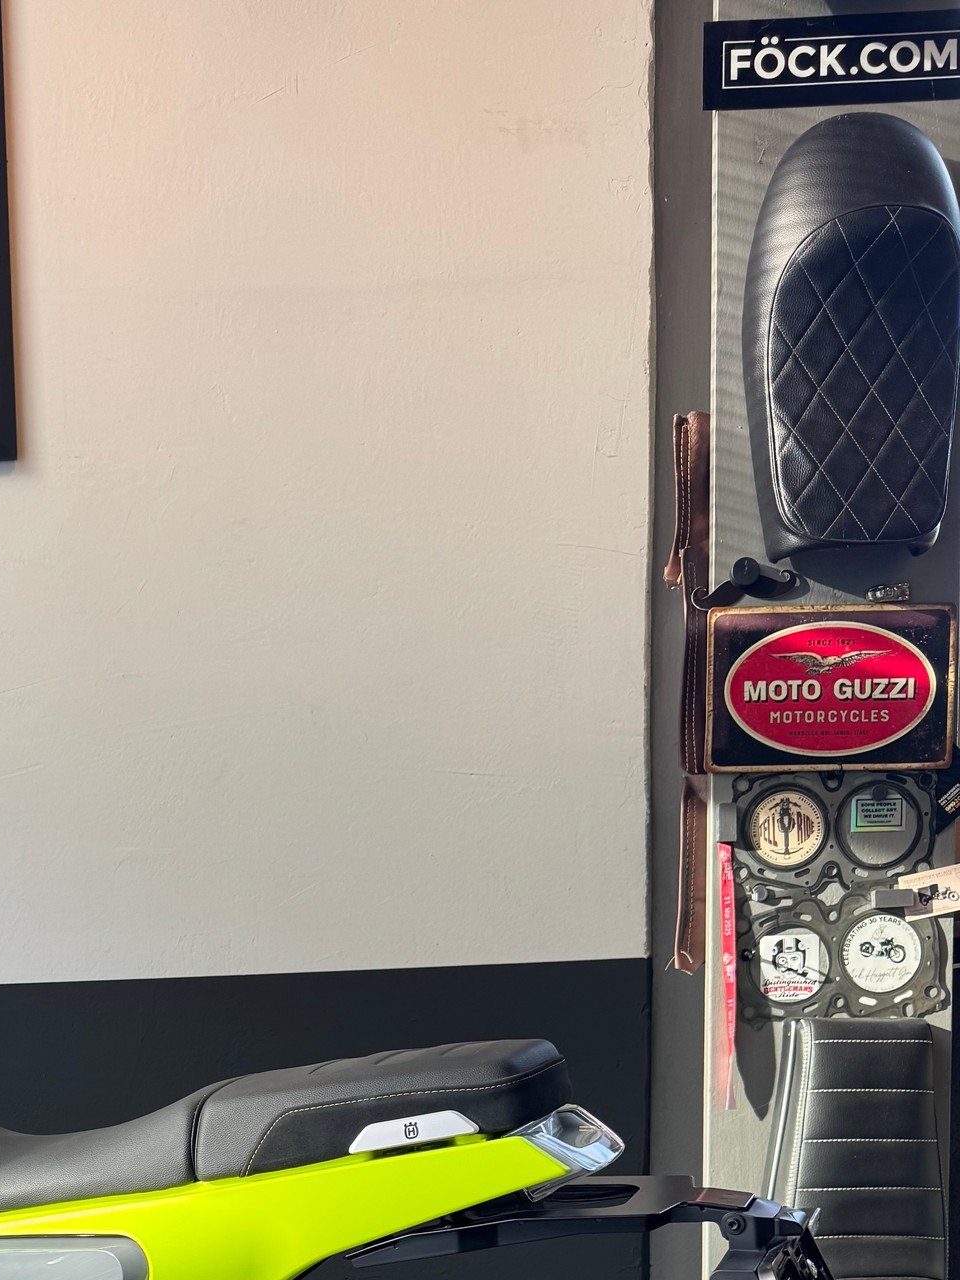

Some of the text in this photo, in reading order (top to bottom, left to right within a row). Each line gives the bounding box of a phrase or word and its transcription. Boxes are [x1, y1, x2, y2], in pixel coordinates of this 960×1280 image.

[730, 36, 958, 81] FÖCK.COM
[807, 638, 856, 647] SINCE 1921
[743, 677, 917, 703] MOTO GUZZI
[769, 709, 890, 724] MOTORCYCLES
[842, 915, 902, 967] CELEBRATING 30 YEARS
